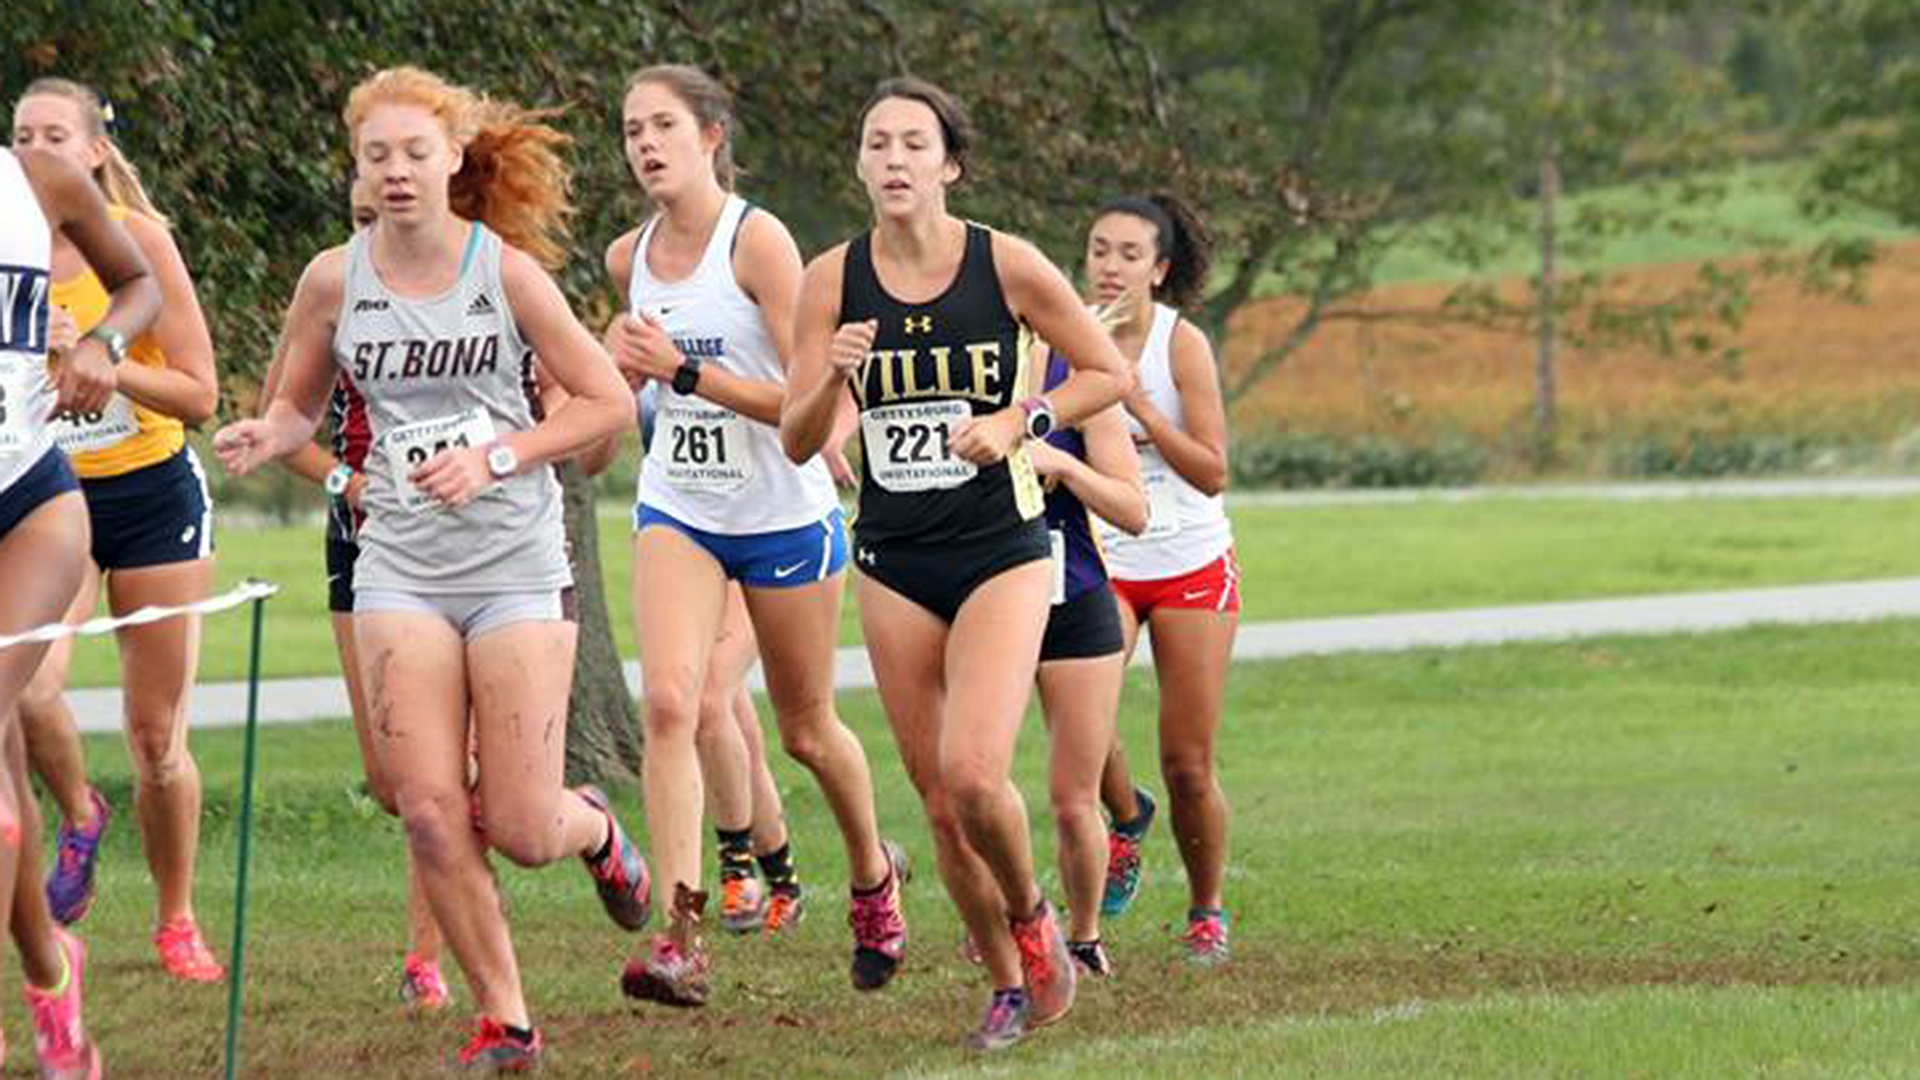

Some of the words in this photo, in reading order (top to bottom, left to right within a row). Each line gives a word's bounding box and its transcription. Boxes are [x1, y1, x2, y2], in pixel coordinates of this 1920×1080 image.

[353, 335, 498, 380] ST.BONA
[870, 404, 962, 420] GETTYSBURG
[672, 424, 726, 465] 261
[886, 421, 950, 463] 221
